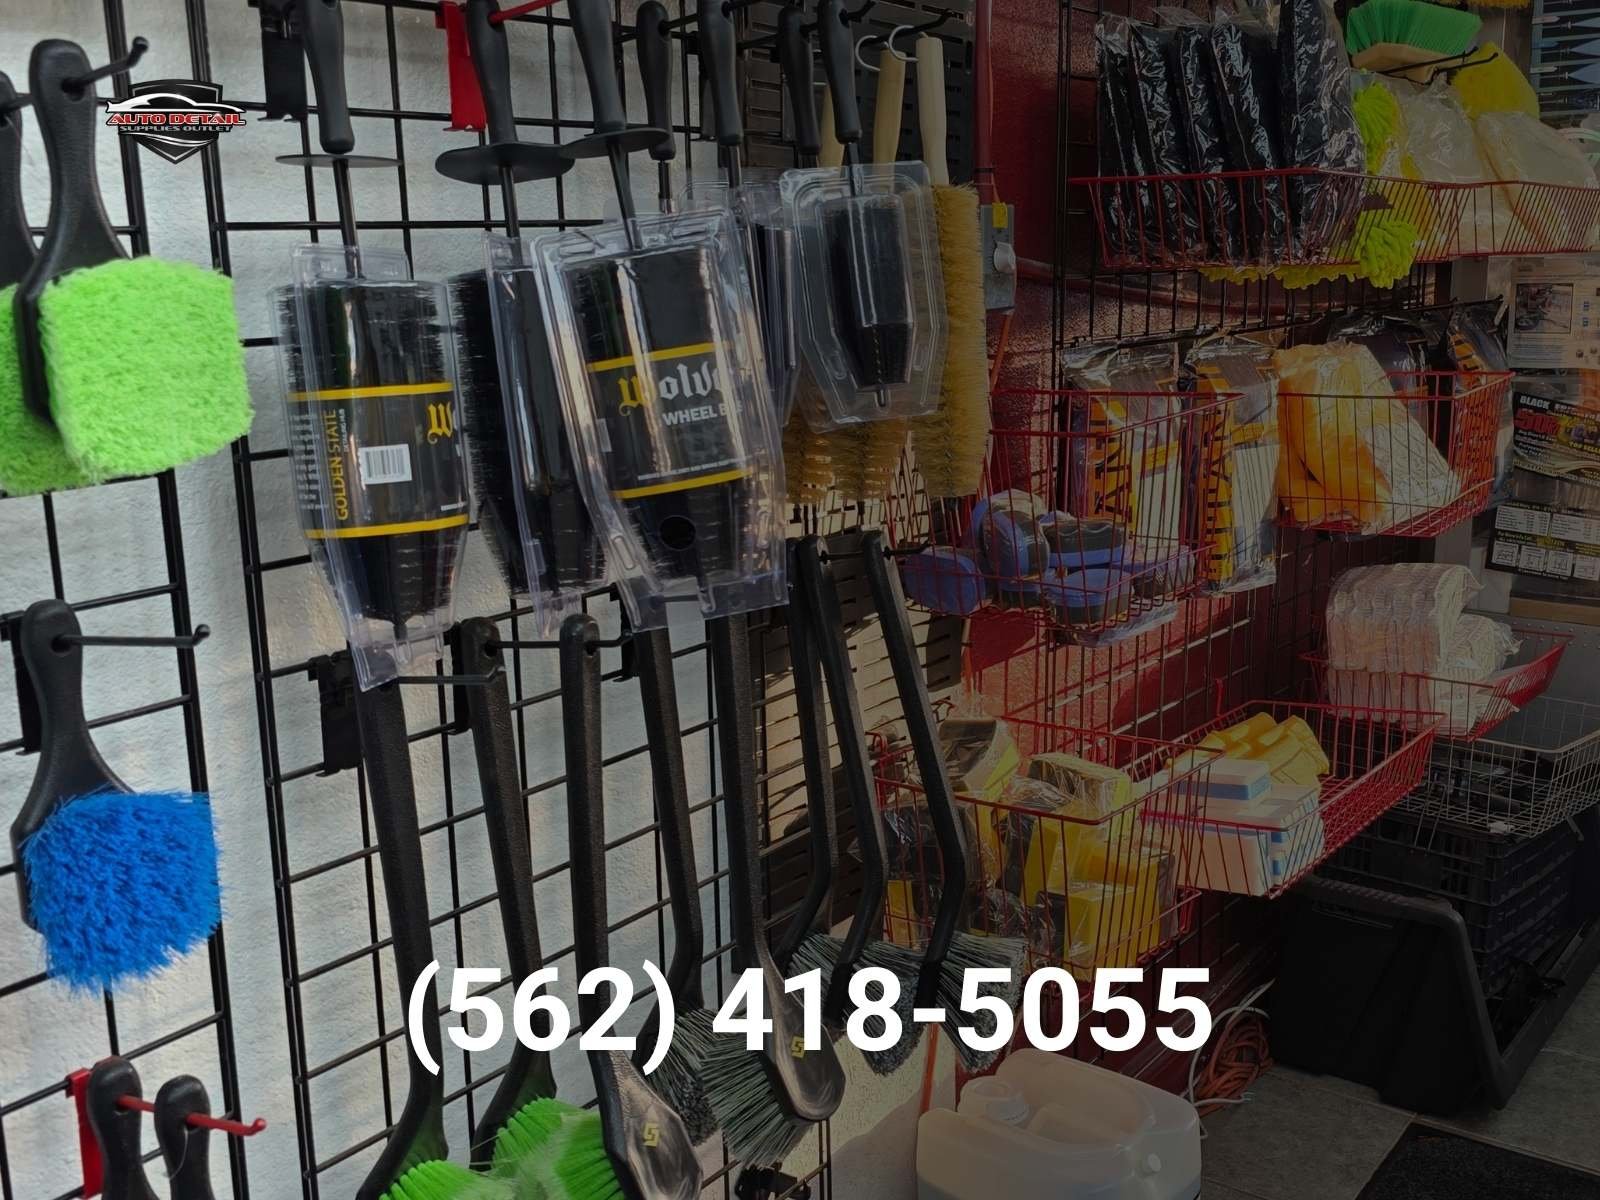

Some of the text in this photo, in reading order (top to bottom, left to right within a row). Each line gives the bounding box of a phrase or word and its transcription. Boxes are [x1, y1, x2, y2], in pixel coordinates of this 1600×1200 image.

[1519, 395, 1551, 410] BLACK
[661, 404, 717, 426] WHEEL
[324, 408, 349, 521] GOLDEN STATE
